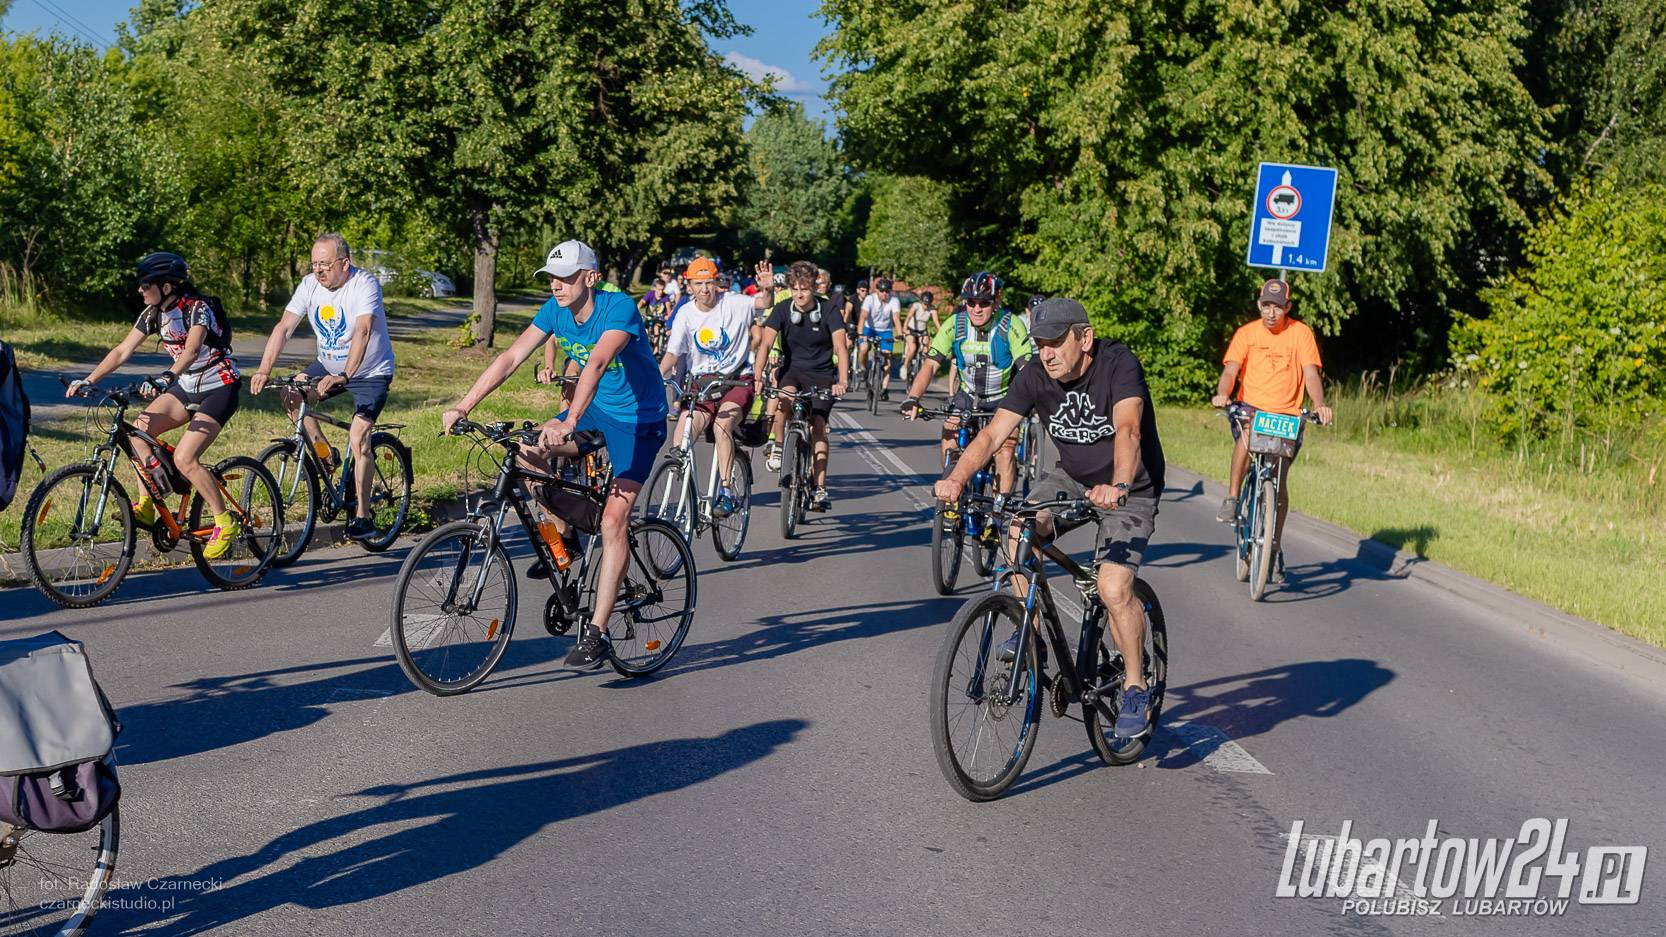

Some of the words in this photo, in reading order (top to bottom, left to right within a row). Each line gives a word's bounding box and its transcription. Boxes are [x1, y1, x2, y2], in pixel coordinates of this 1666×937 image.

[1305, 257, 1317, 266] km
[1049, 422, 1116, 443] Kappa
[1258, 416, 1295, 433] MACIEK
